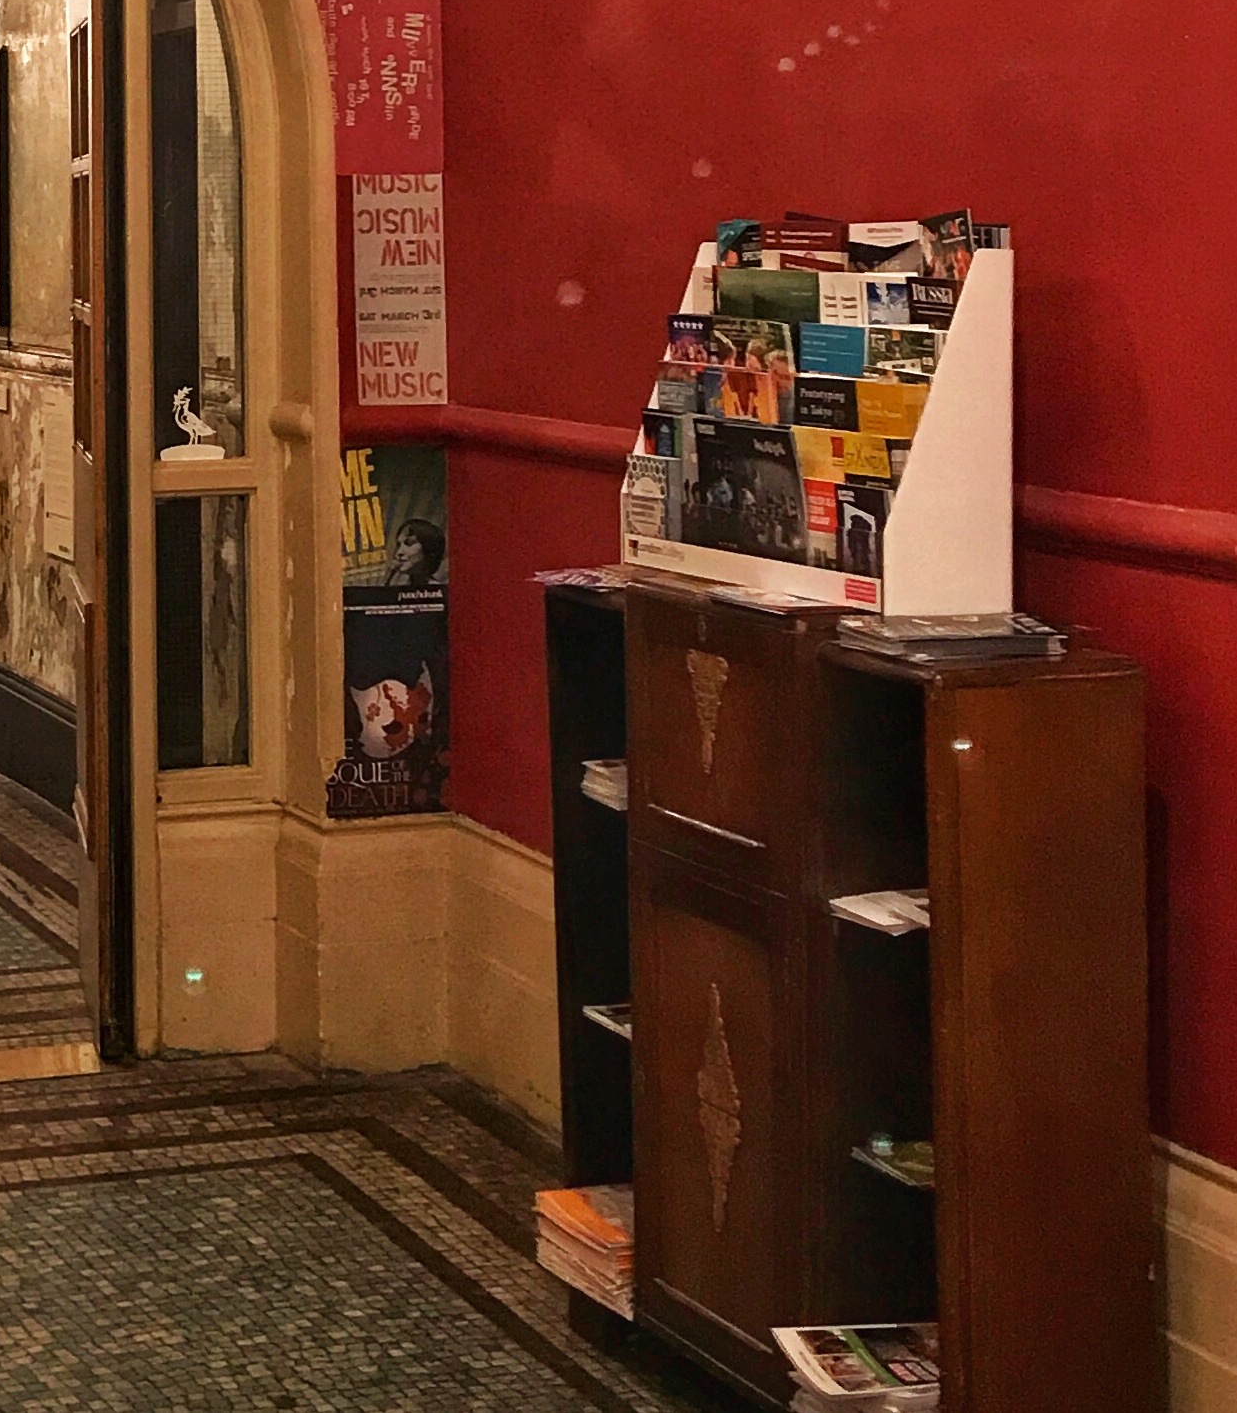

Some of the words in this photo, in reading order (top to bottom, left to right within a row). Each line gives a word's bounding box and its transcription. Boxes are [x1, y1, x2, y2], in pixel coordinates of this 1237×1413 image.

[358, 312, 376, 322] SAT
[380, 312, 420, 323] MARCH
[423, 309, 441, 321] 3rd
[359, 341, 420, 368] NEW
[361, 372, 444, 401] MUSIC
